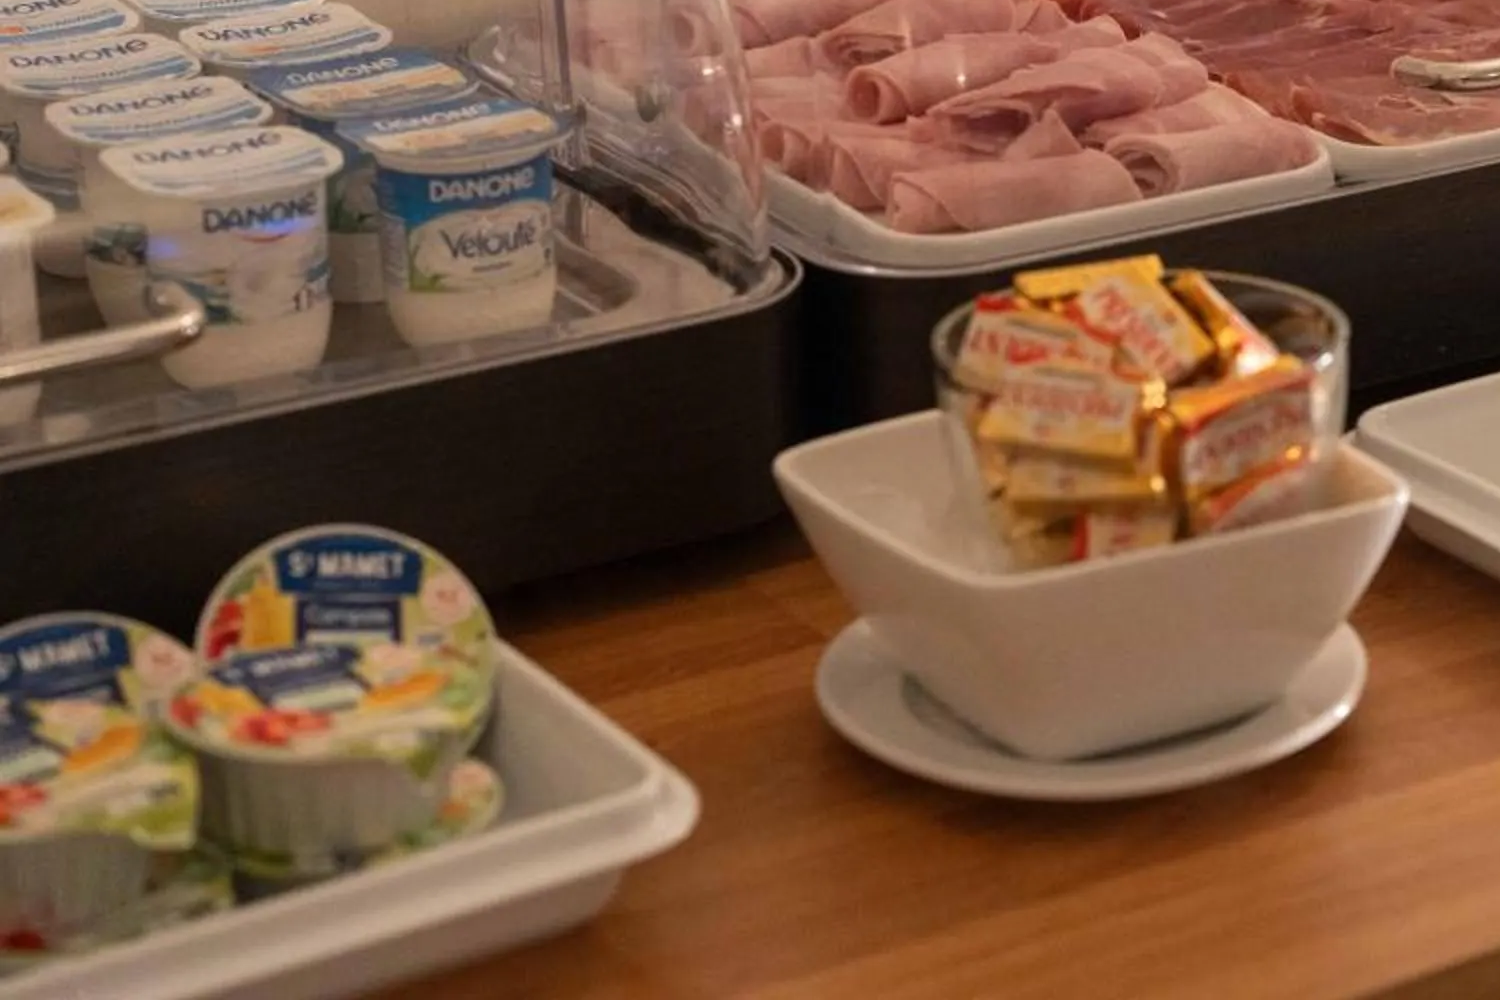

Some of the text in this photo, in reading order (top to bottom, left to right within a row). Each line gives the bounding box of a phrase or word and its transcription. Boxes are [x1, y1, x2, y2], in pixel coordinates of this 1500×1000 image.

[198, 13, 330, 41] DANONE
[10, 38, 148, 67] DANONE
[286, 56, 399, 85] DANONE
[68, 84, 213, 115] DANONE
[133, 132, 282, 163] DANONE
[430, 167, 535, 203] DANONE
[202, 191, 317, 234] DANONE
